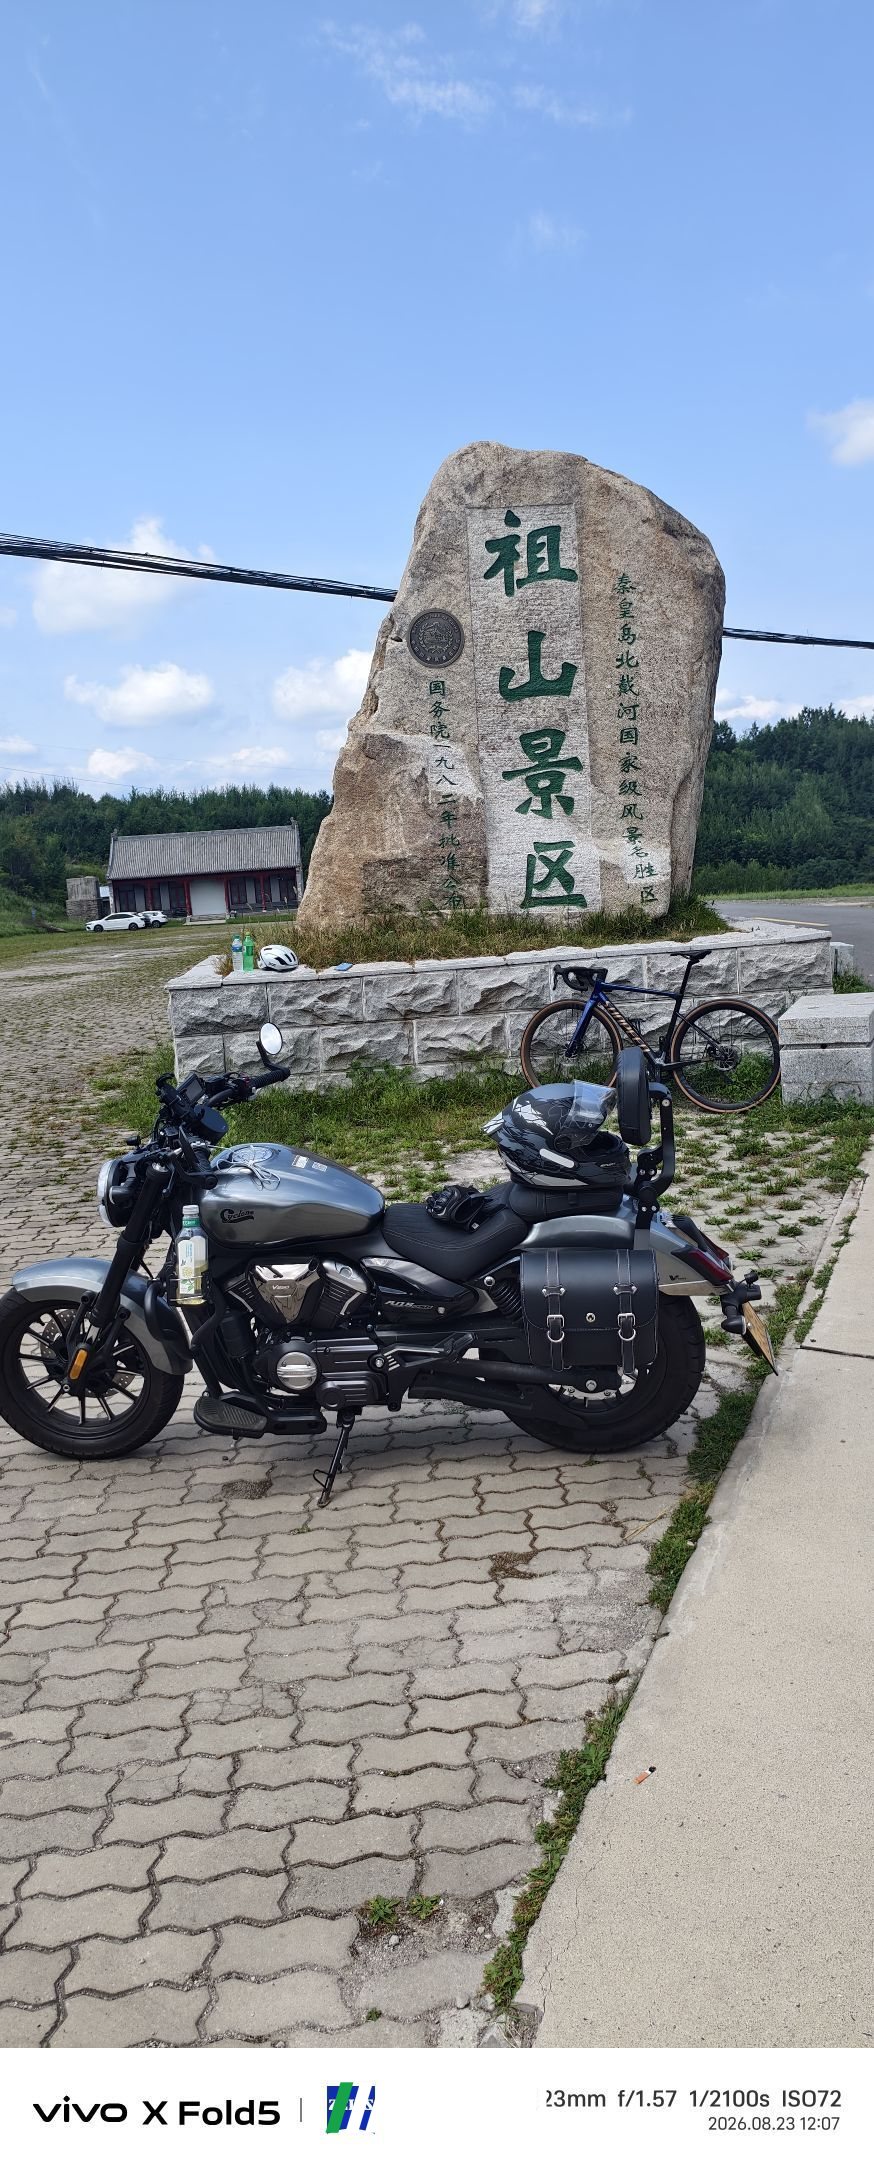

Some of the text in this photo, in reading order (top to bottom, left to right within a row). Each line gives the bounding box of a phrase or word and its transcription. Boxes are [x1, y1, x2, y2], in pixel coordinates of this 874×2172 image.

[428, 680, 466, 909] 国务院一九八二年批准公布
[484, 510, 588, 909] 祖山景区
[614, 573, 659, 904] 秦皇岛北戴河国家级风景名胜区
